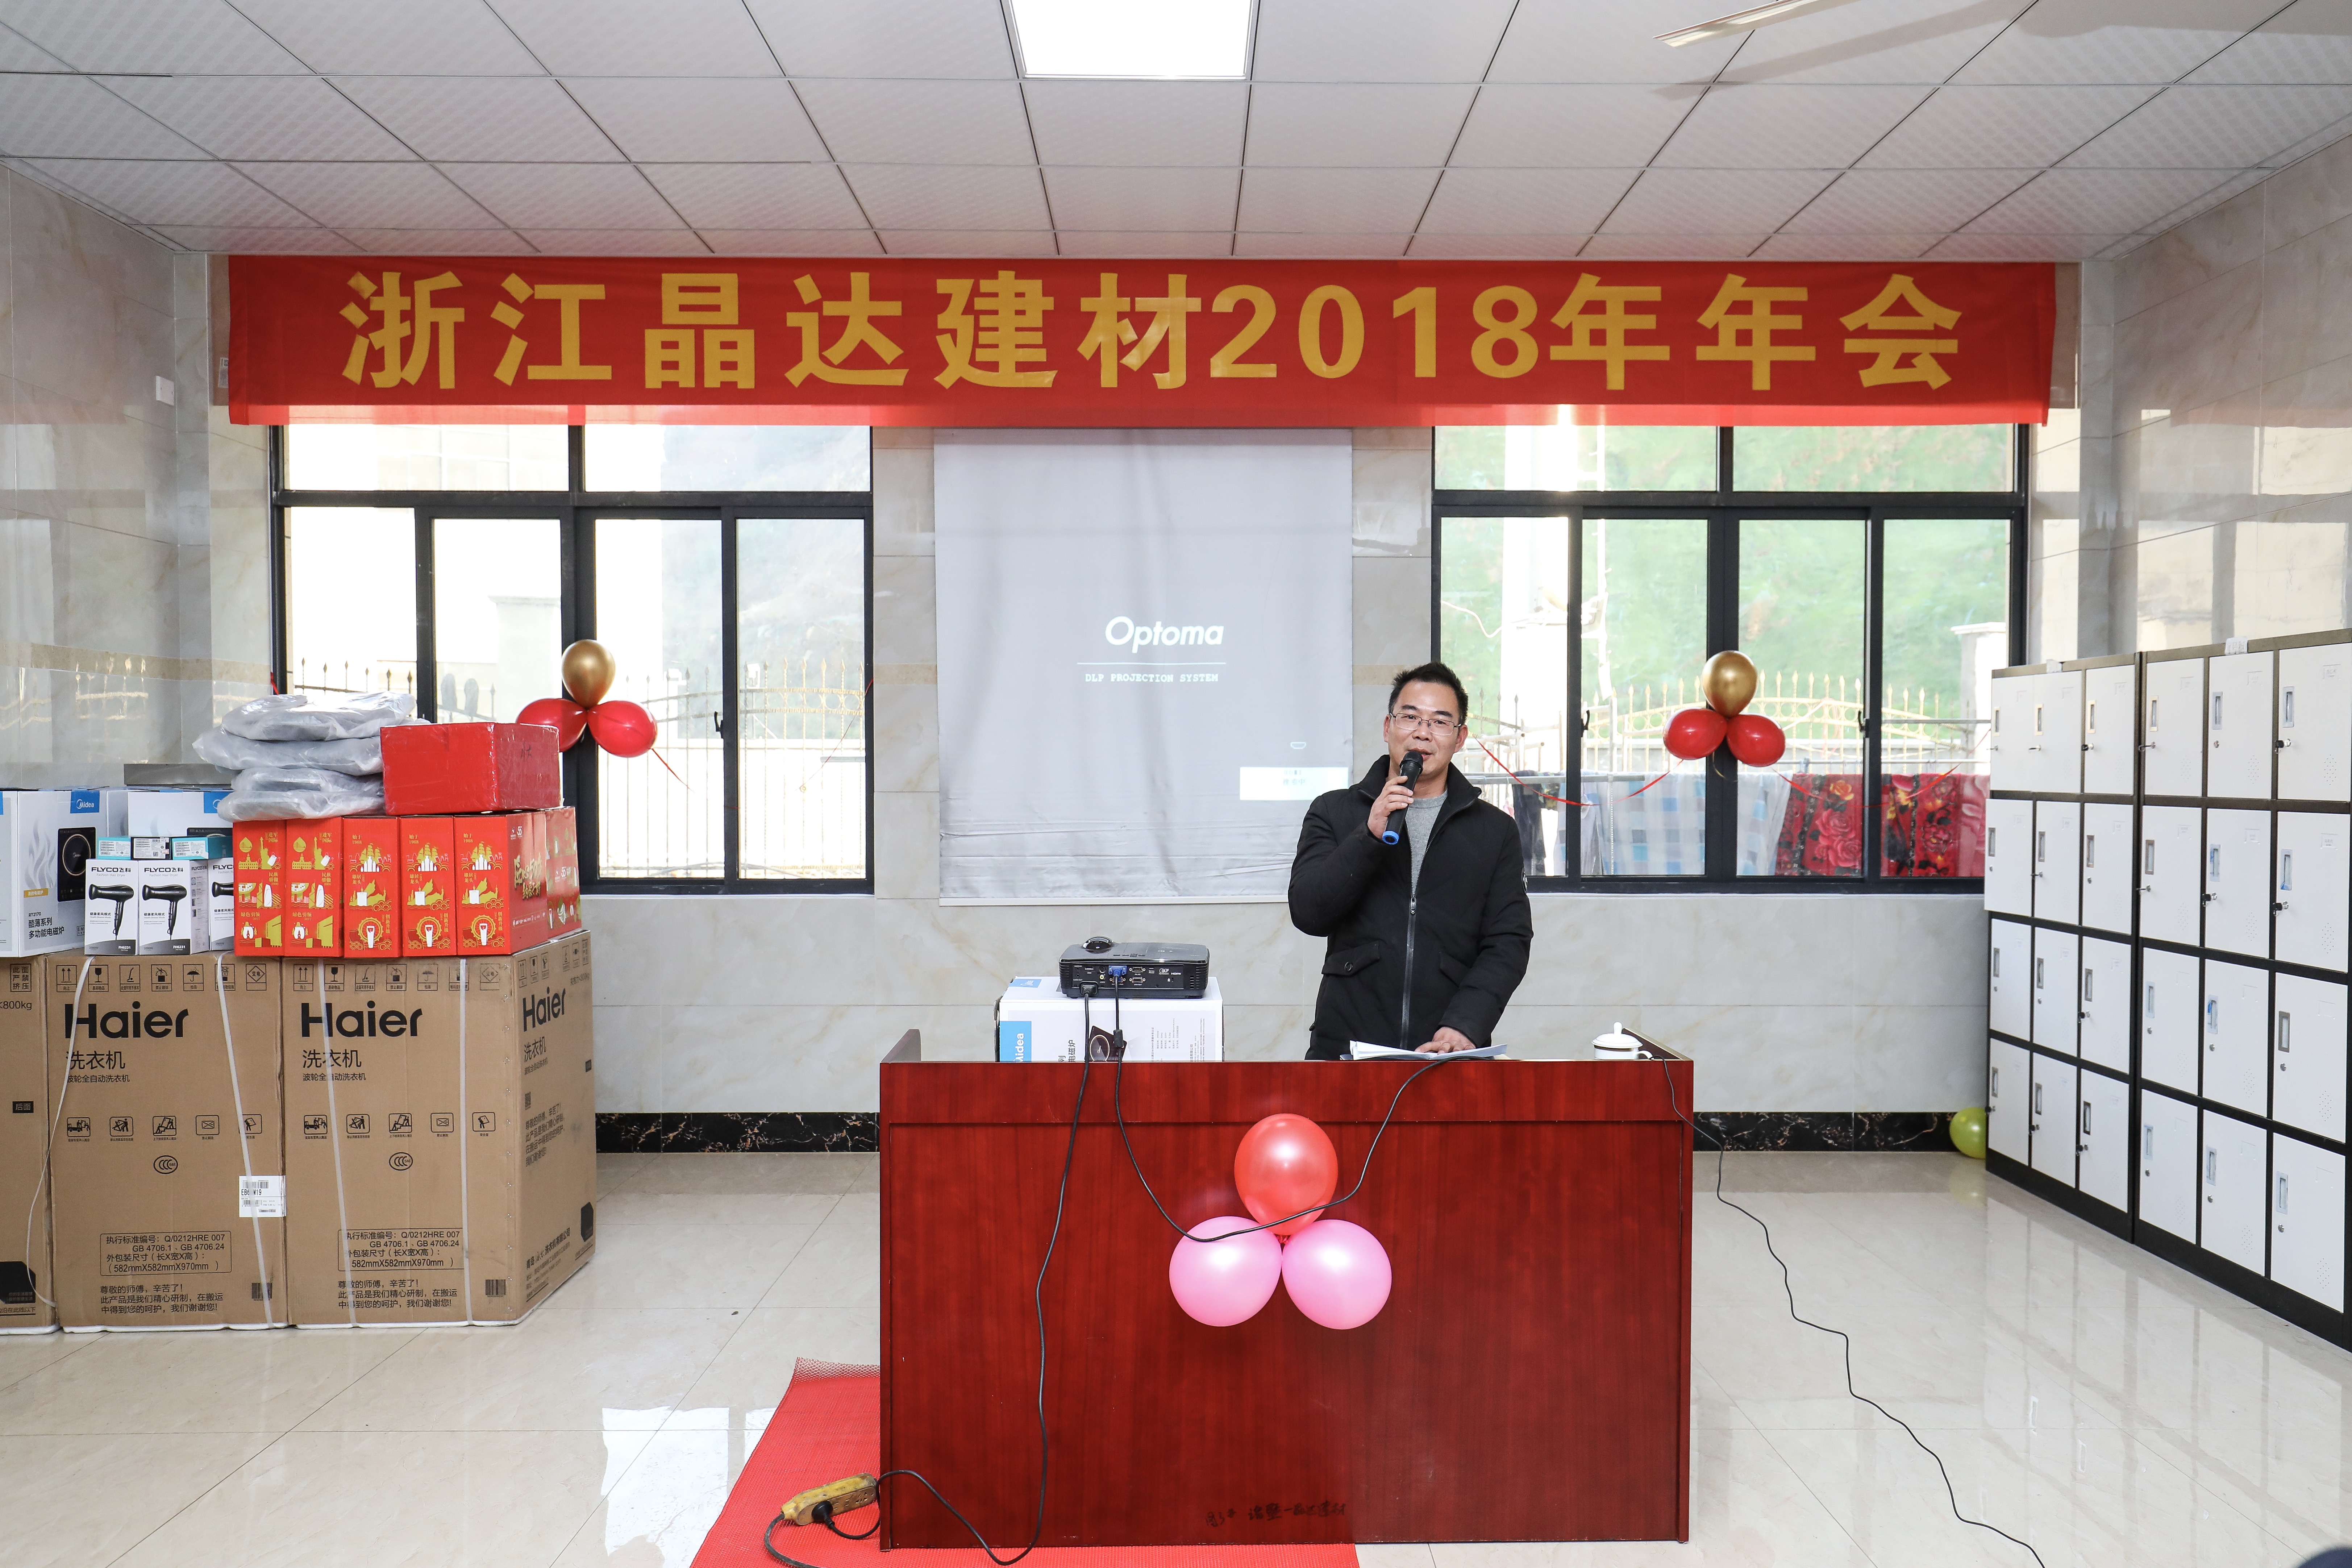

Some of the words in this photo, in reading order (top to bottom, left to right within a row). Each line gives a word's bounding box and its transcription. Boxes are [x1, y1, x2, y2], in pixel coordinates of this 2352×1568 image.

[341, 270, 1962, 390] 浙江晶达建材2018年年会
[1105, 616, 1224, 654] Optoma
[1085, 674, 1104, 682] DLP
[1111, 674, 1173, 682] PROJECTION
[1180, 674, 1219, 682] SYSTEM
[76, 799, 94, 809] Midea
[29, 917, 52, 928] 酷薄系列
[29, 926, 64, 939] 多功能电磁炉
[301, 1001, 423, 1037] Haier
[523, 986, 566, 1032] Haier
[65, 1001, 188, 1039] Haier
[524, 1036, 546, 1062] 洗衣机
[1013, 1033, 1024, 1062] Midea
[66, 1050, 126, 1070] 洗衣机
[302, 1049, 362, 1069] 洗衣机
[15, 1103, 31, 1111] 后面
[352, 1259, 444, 1268] 582mmX582mmX970mm
[100, 1293, 224, 1304] 此产品是我们精心研制，在搬运
